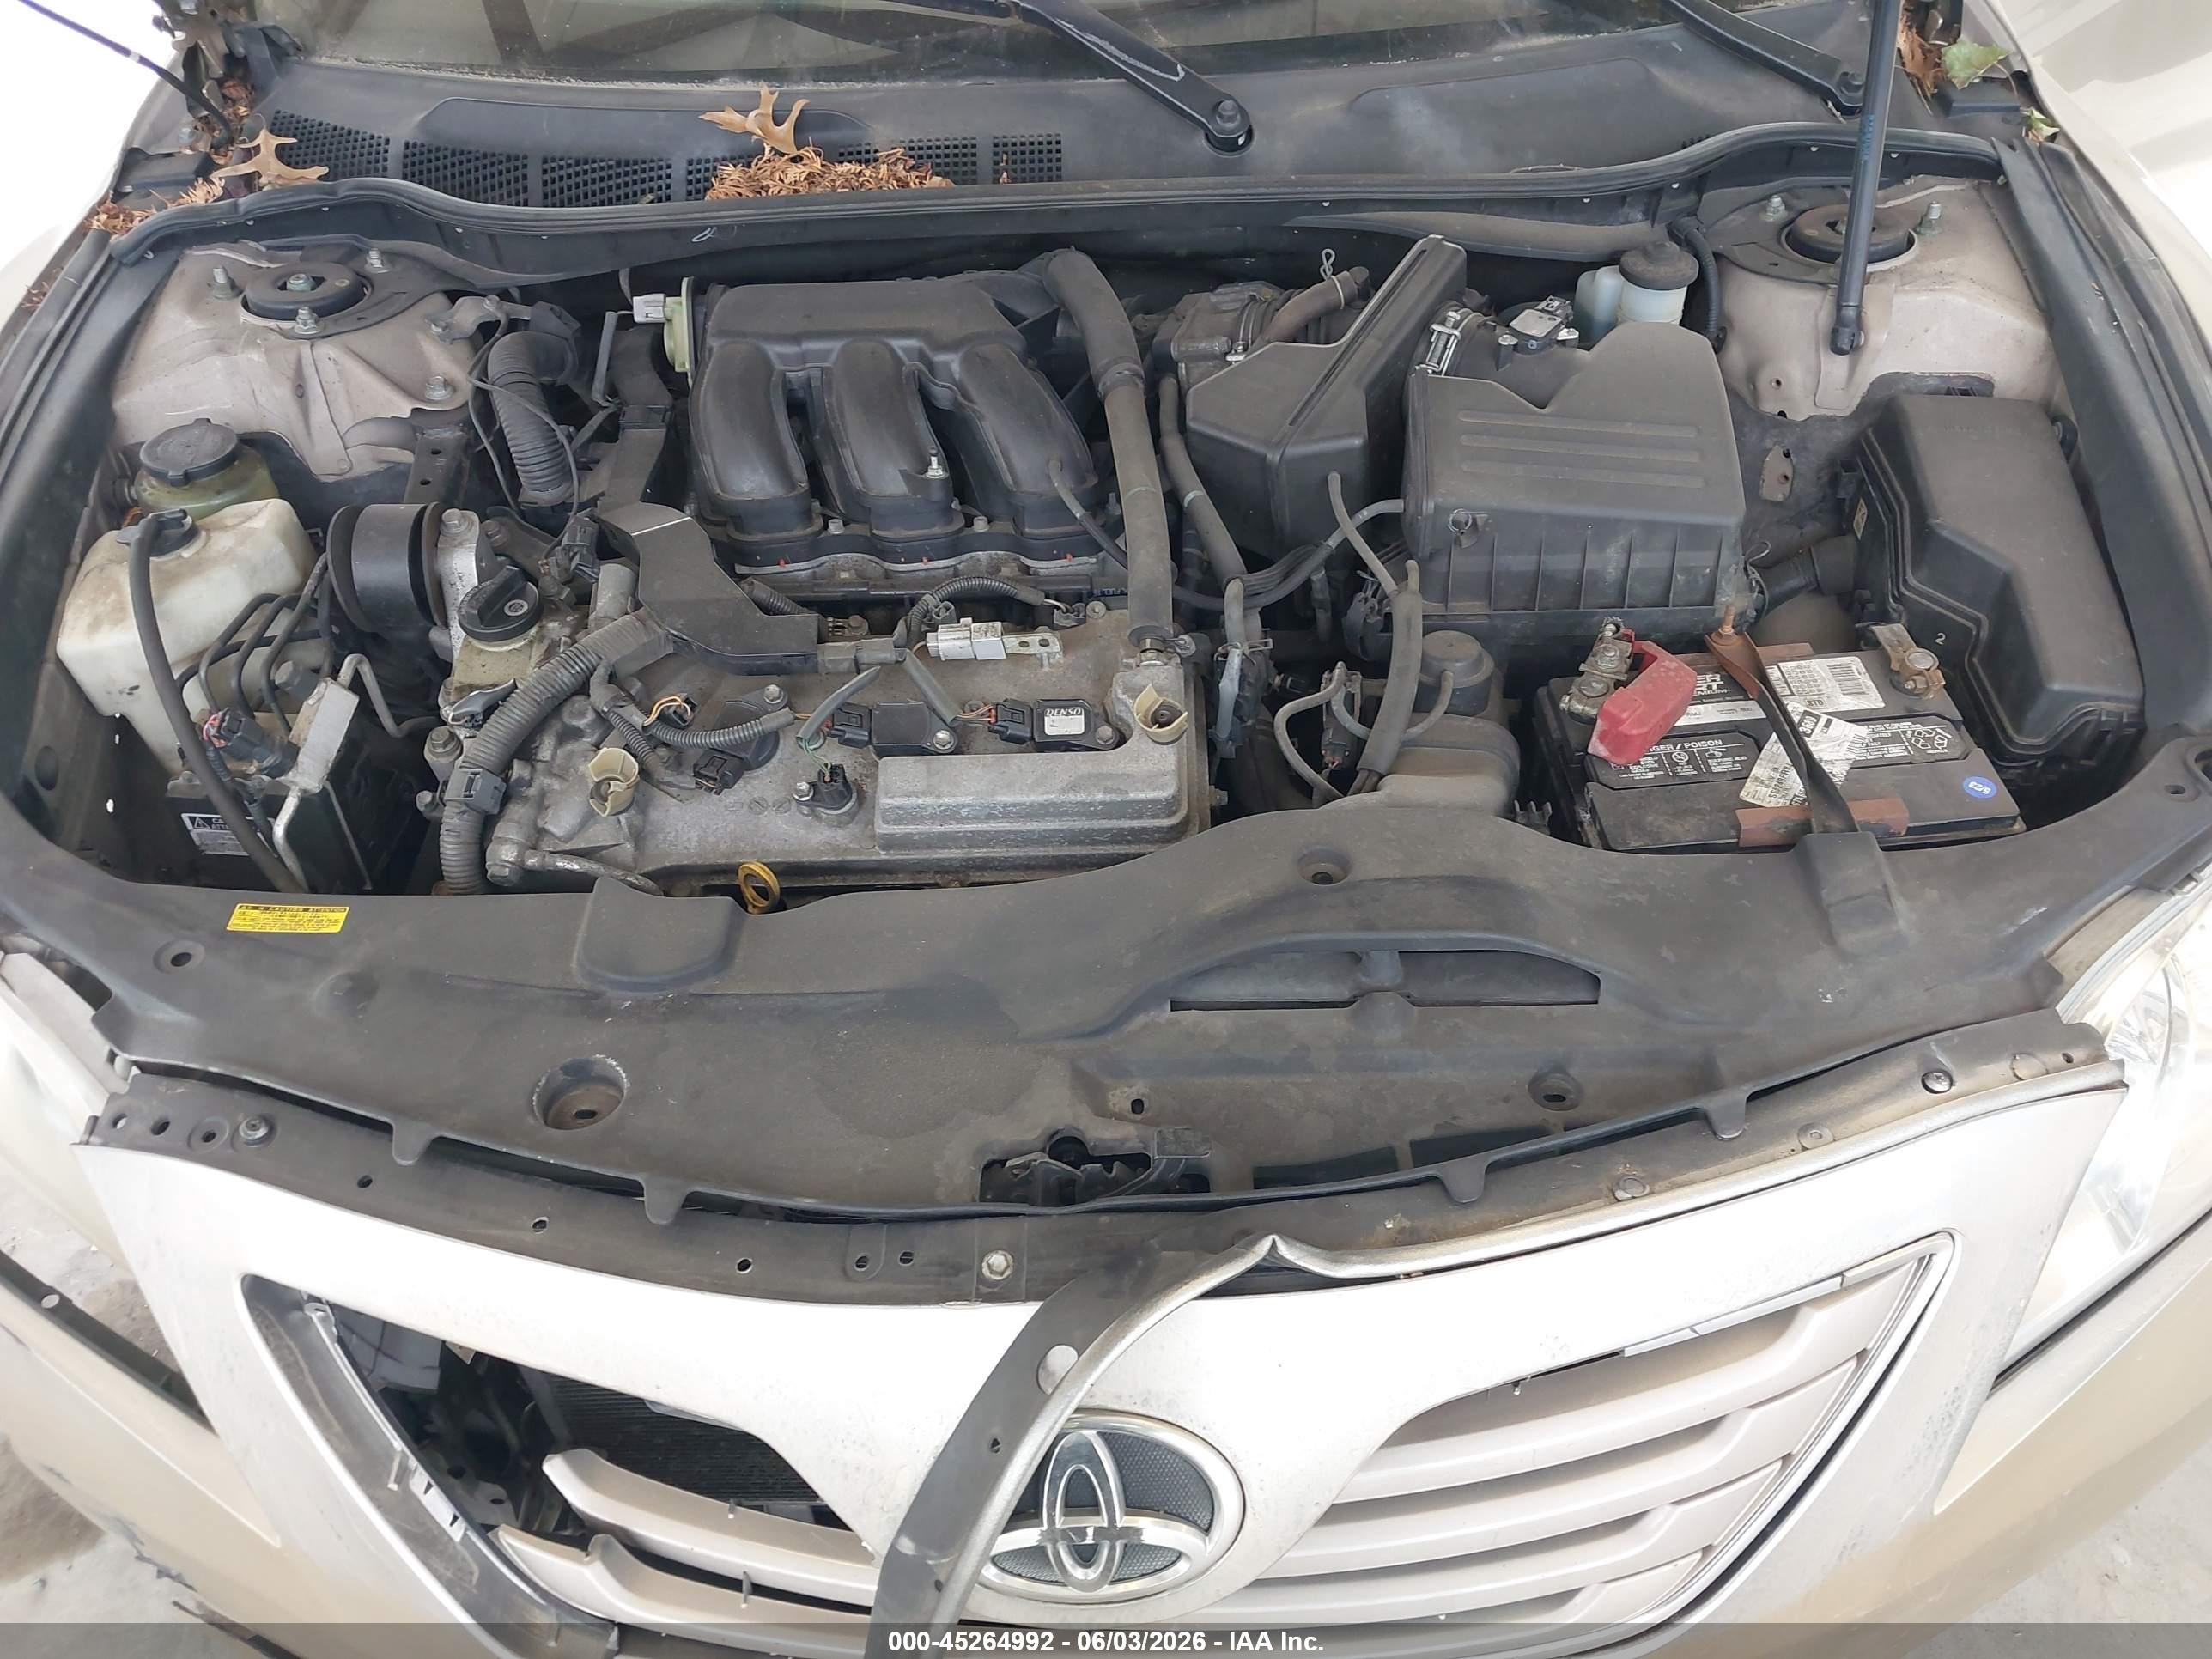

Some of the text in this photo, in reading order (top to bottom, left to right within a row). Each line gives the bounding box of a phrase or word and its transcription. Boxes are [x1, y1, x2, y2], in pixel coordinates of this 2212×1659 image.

[1935, 632, 1946, 646] 2
[1806, 699, 1824, 708] STD
[1046, 708, 1081, 716] DENSO
[1684, 739, 1723, 750] POISON
